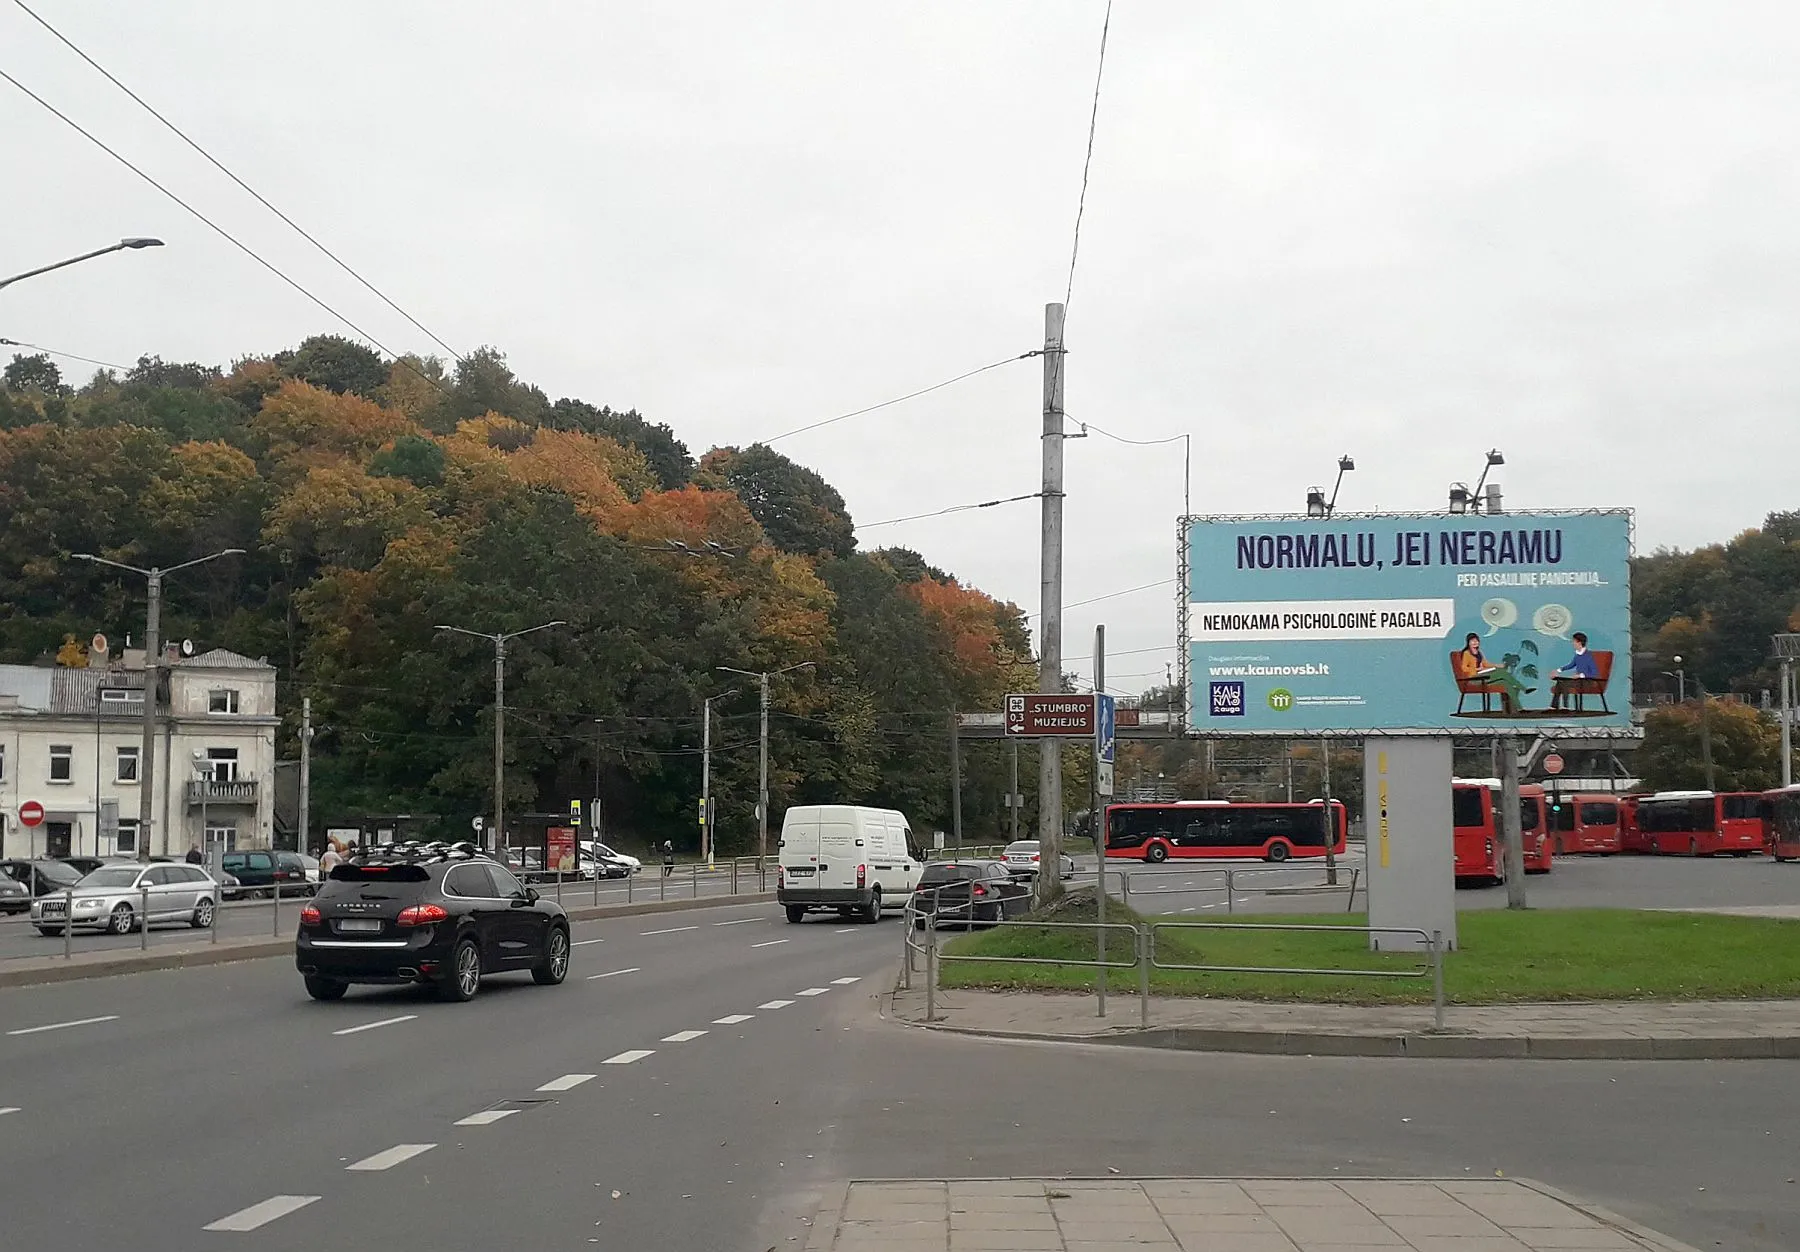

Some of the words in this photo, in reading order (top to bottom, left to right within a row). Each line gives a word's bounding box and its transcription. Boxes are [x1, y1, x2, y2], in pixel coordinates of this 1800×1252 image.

[1237, 533, 1384, 571] NORMALU,
[1392, 532, 1430, 566] JEI
[1440, 529, 1562, 565] NERAMU
[1457, 573, 1478, 587] PER
[1204, 614, 1280, 631] NEMOKAMA
[1284, 610, 1377, 630] PSICHOLOGINĖ
[1381, 611, 1441, 628] PAGALBA
[1209, 663, 1329, 676] www.kaunovsb.lt
[1009, 713, 1024, 722] 0,3
[1034, 717, 1087, 727] MUZIEJUS
